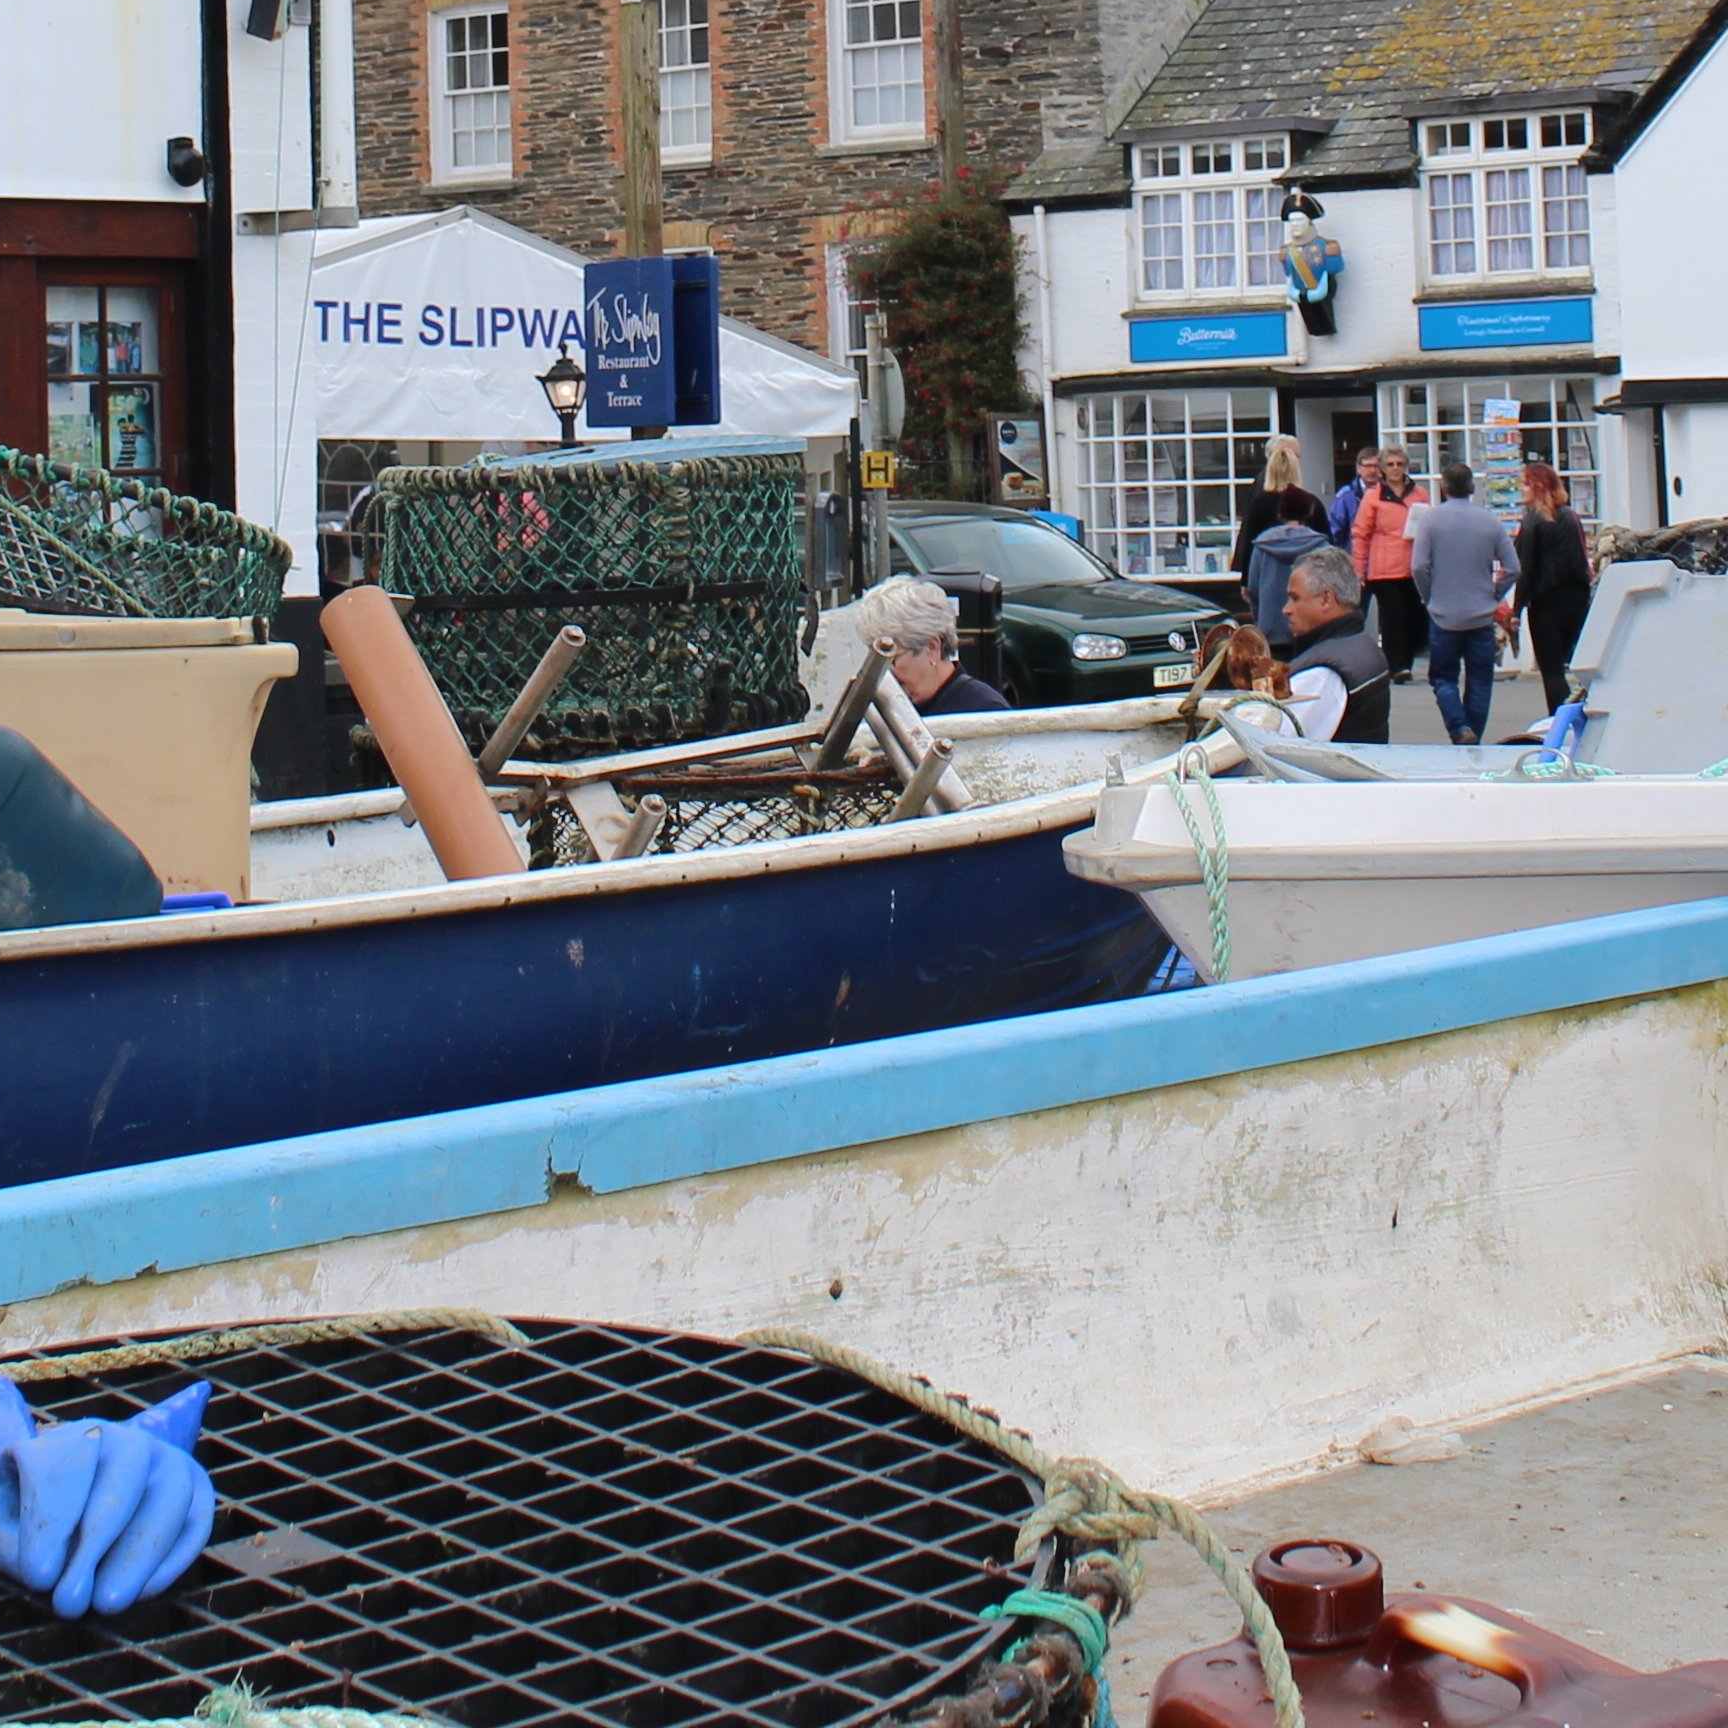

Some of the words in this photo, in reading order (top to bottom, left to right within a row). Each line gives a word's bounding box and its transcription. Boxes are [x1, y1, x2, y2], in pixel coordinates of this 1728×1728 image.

[314, 300, 403, 344] THE
[419, 305, 587, 350] SLIPWA
[1176, 326, 1237, 345] Buttermilk
[597, 355, 650, 370] Restaurant
[619, 374, 629, 389] &
[607, 391, 643, 408] Terrace
[867, 456, 889, 483] H
